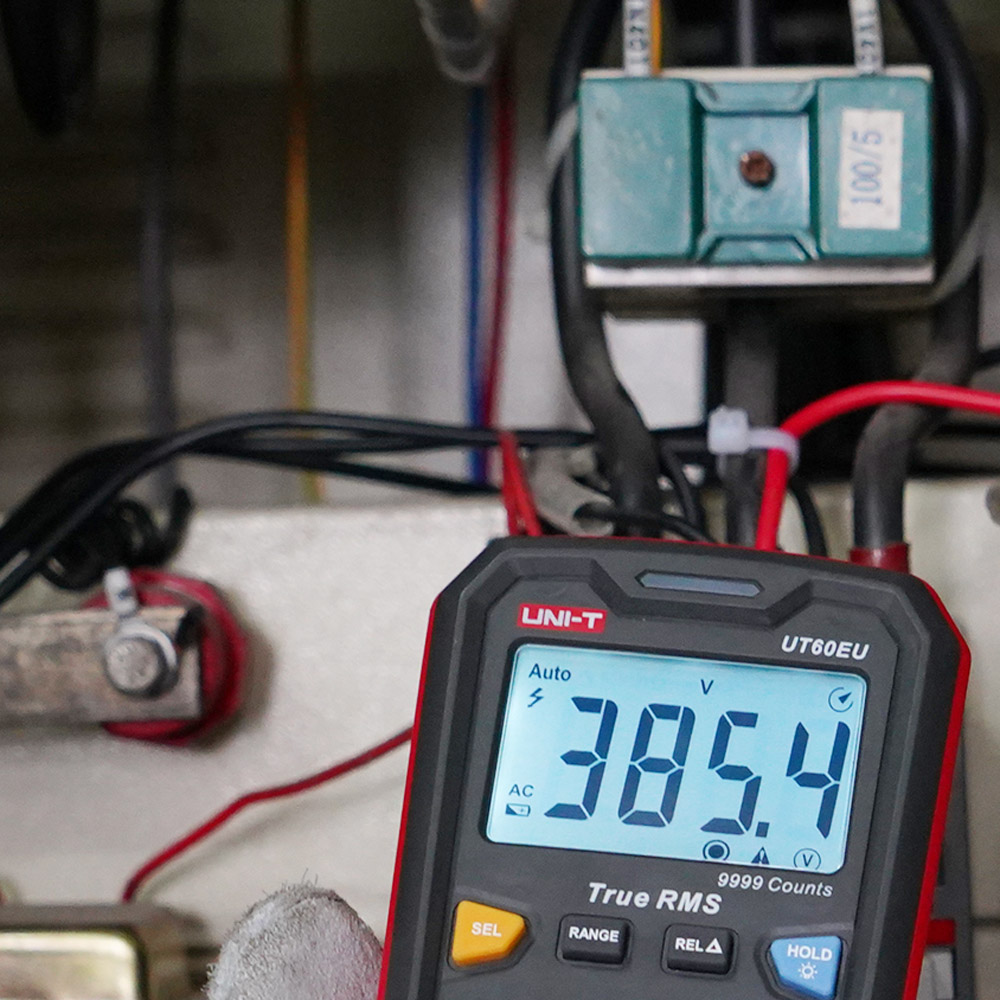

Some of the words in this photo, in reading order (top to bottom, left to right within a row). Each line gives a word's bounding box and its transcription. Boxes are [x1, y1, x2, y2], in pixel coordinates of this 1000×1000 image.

[851, 128, 882, 207] 100/5
[521, 606, 604, 632] UNI-T
[780, 635, 870, 662] UT60EU
[528, 663, 572, 684] Auto
[699, 679, 715, 696] V
[543, 695, 851, 840] 385.4
[508, 784, 534, 798] AC
[717, 872, 764, 891] 9999
[767, 876, 834, 898] Counts
[588, 881, 650, 908] True
[655, 888, 723, 915] RMS
[471, 922, 502, 938] SEL
[568, 926, 620, 943] RANGE
[786, 944, 833, 962] HOLD
